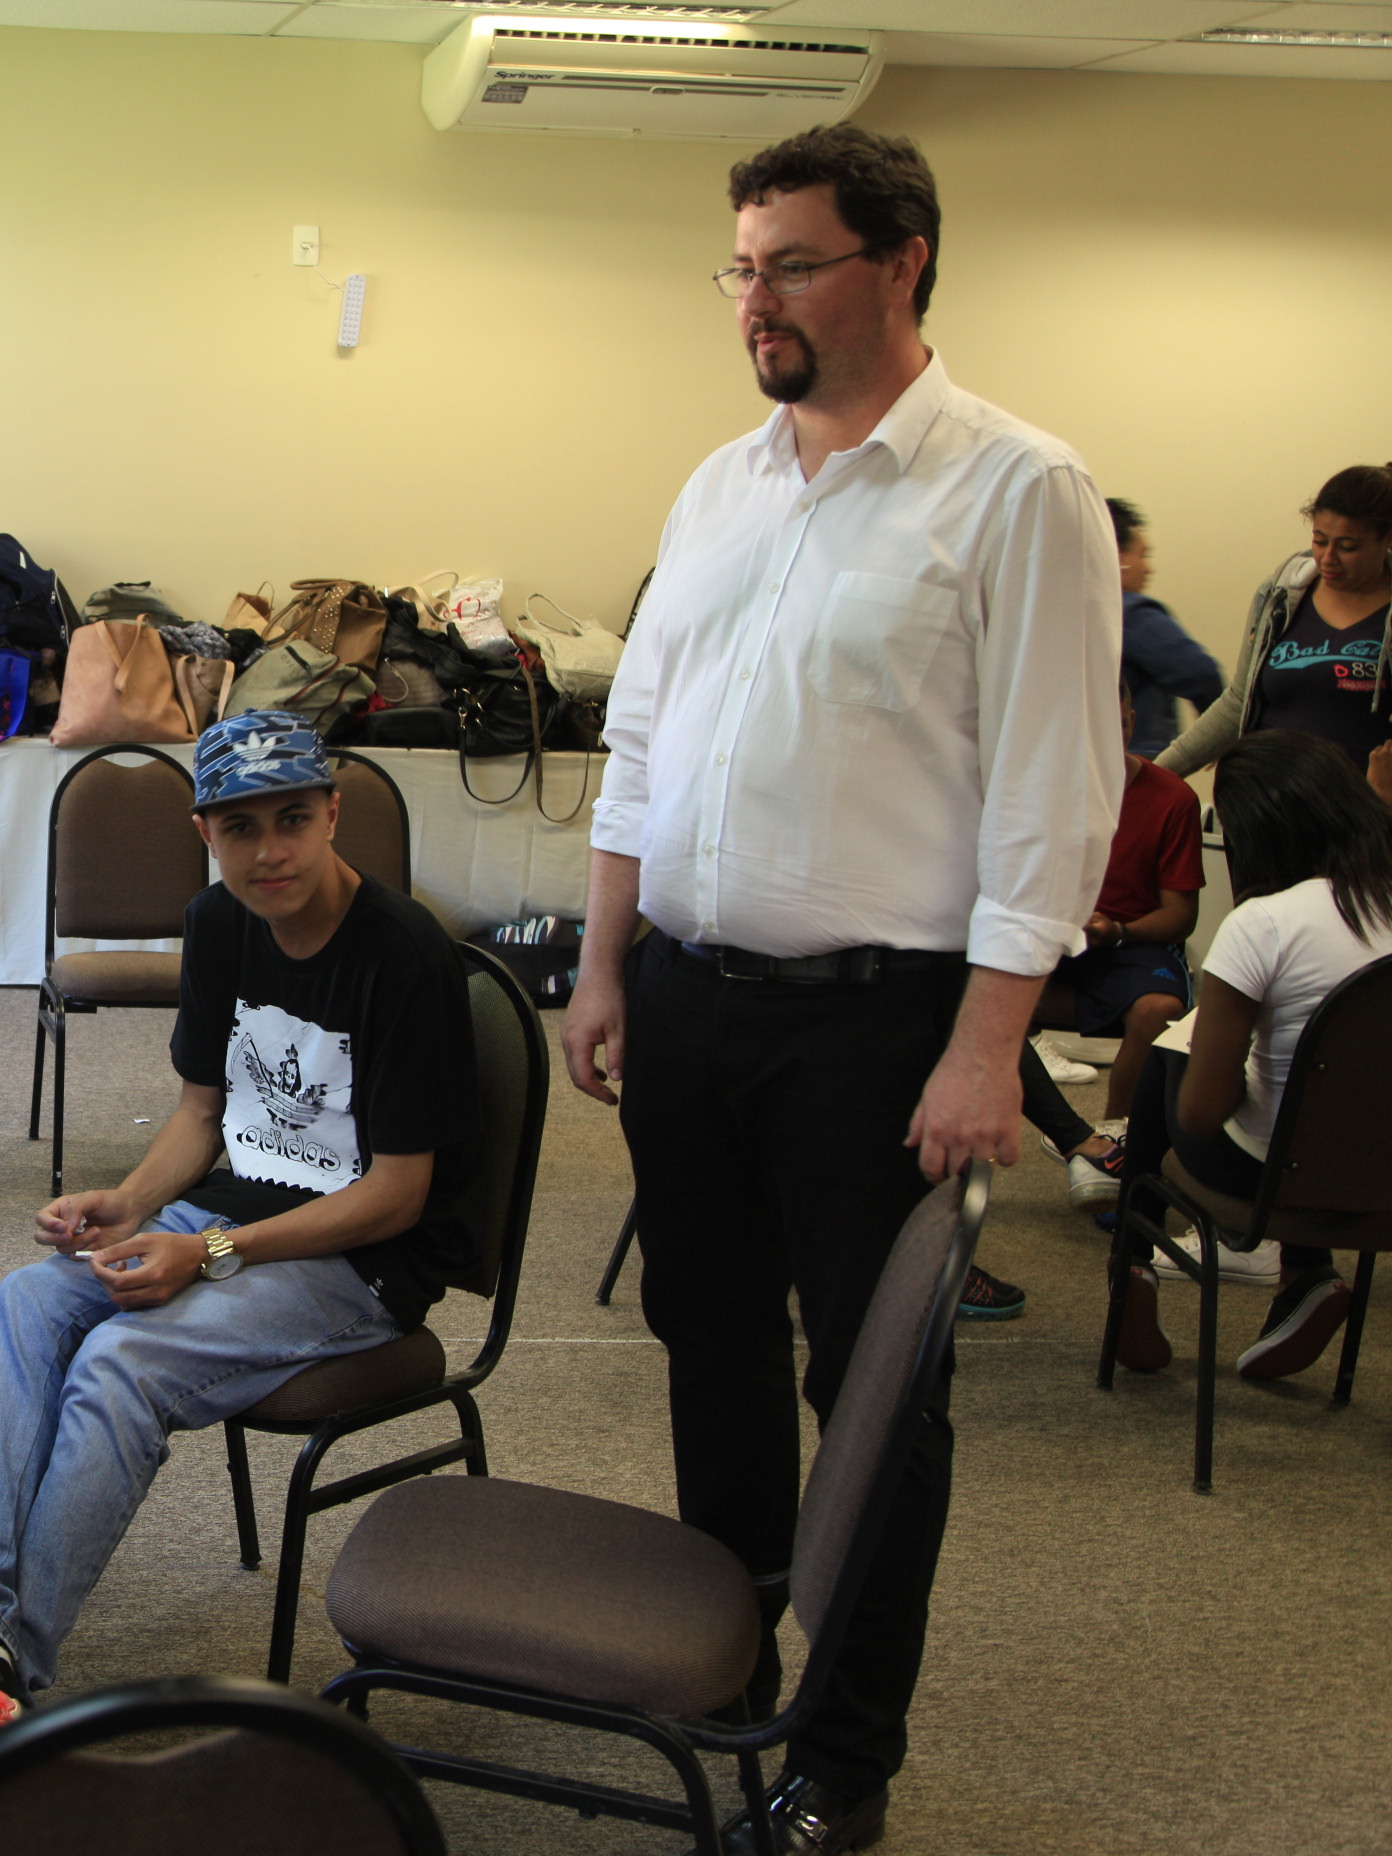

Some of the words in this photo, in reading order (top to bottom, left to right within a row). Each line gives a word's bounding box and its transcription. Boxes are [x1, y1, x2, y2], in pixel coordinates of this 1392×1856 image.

[494, 71, 555, 80] Springer
[1269, 640, 1329, 666] Bad
[236, 1125, 341, 1172] adidas
